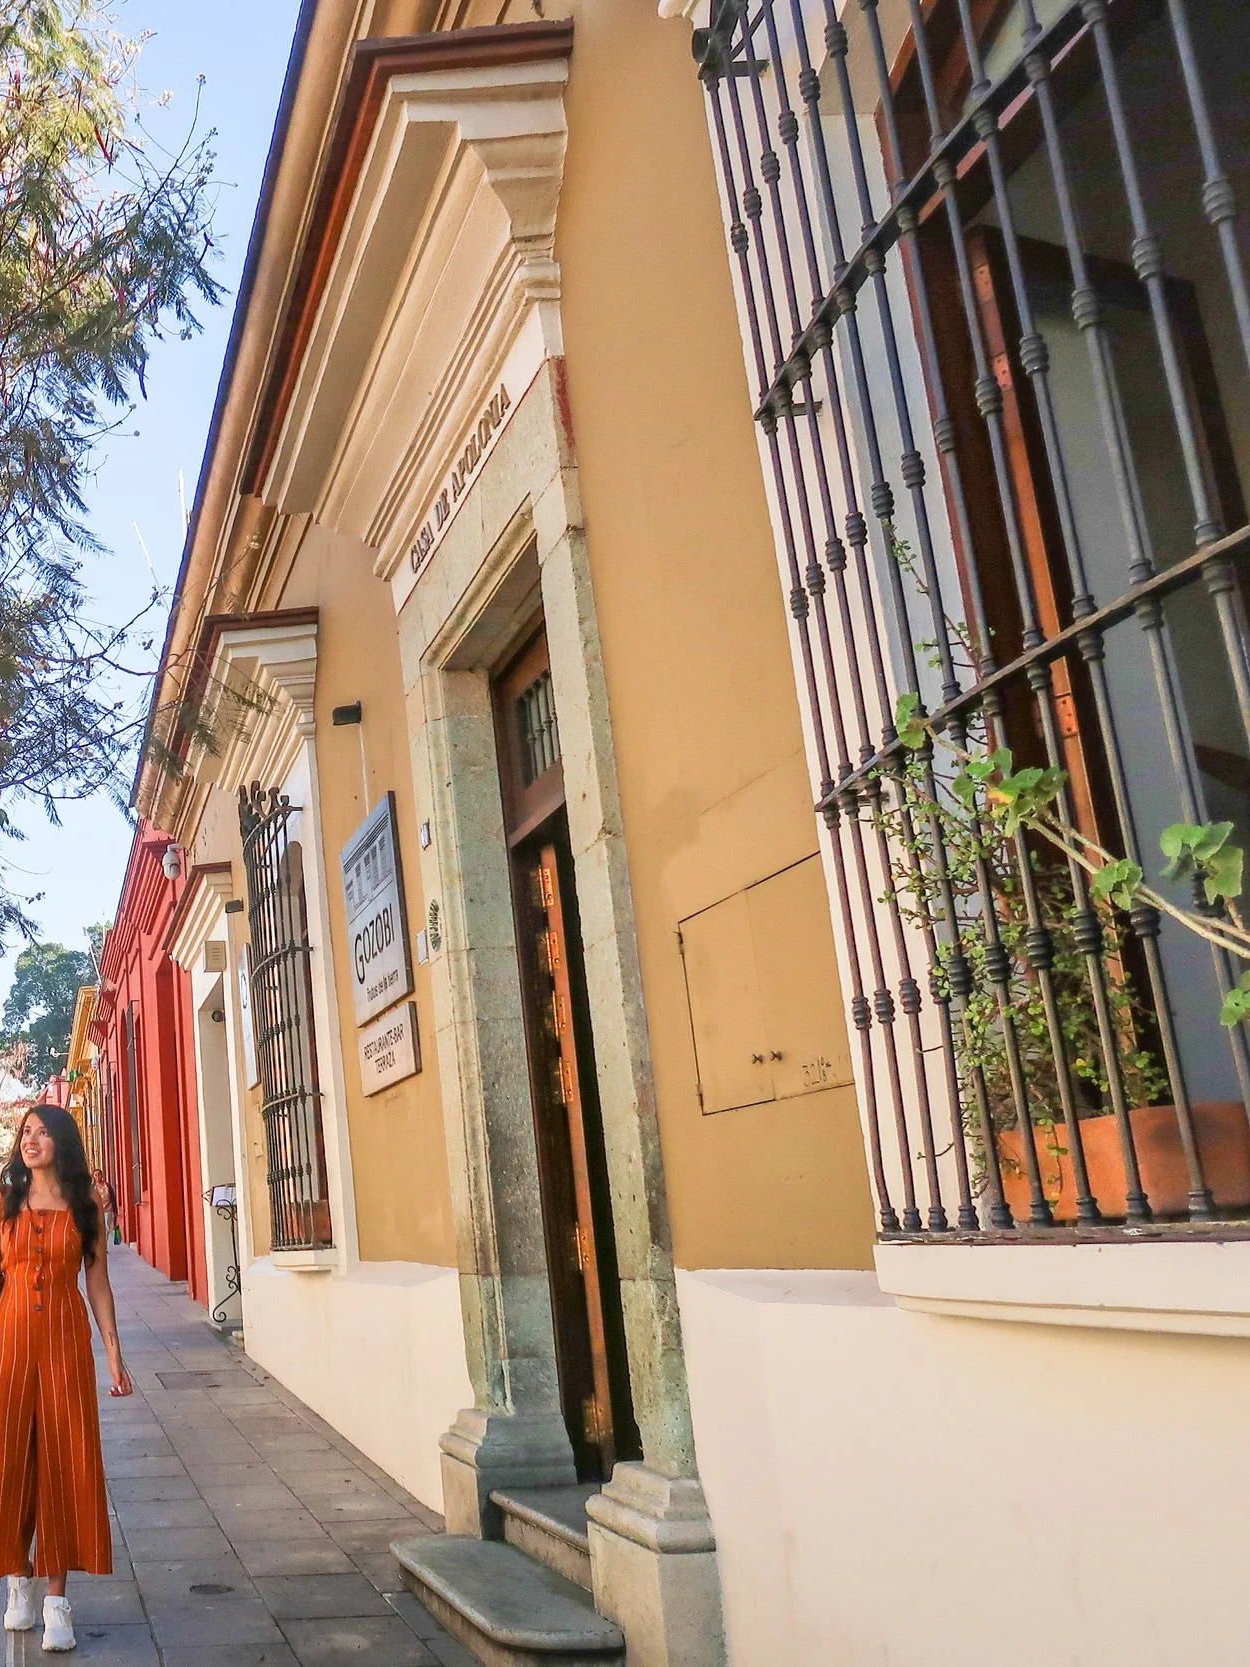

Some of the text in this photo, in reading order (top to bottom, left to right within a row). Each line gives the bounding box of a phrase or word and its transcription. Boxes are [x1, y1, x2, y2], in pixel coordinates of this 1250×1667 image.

[411, 521, 435, 574] CASA
[435, 488, 450, 532] DE
[354, 903, 395, 985] GOZOBI
[374, 1050, 396, 1076] TERRAZA
